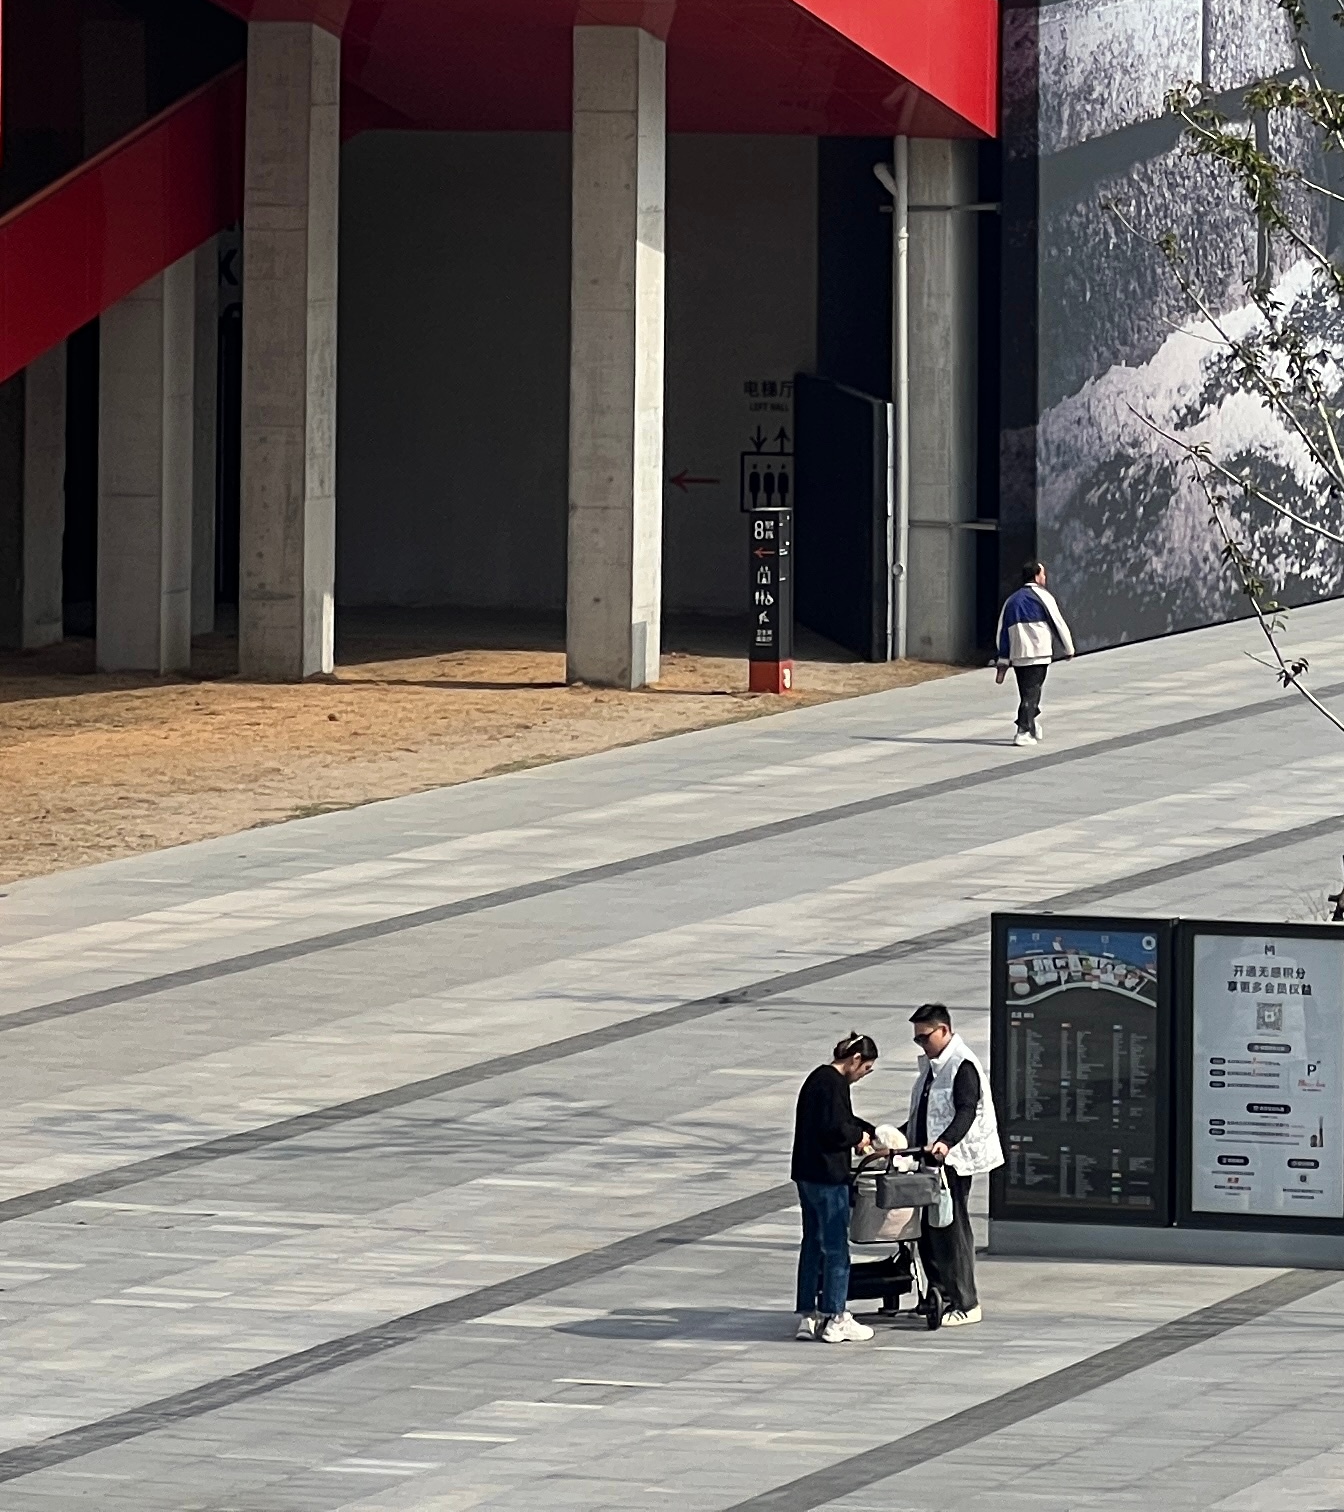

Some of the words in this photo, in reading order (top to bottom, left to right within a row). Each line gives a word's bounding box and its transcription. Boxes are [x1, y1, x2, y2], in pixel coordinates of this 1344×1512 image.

[744, 380, 794, 397] 电梯厅
[754, 520, 764, 539] 8
